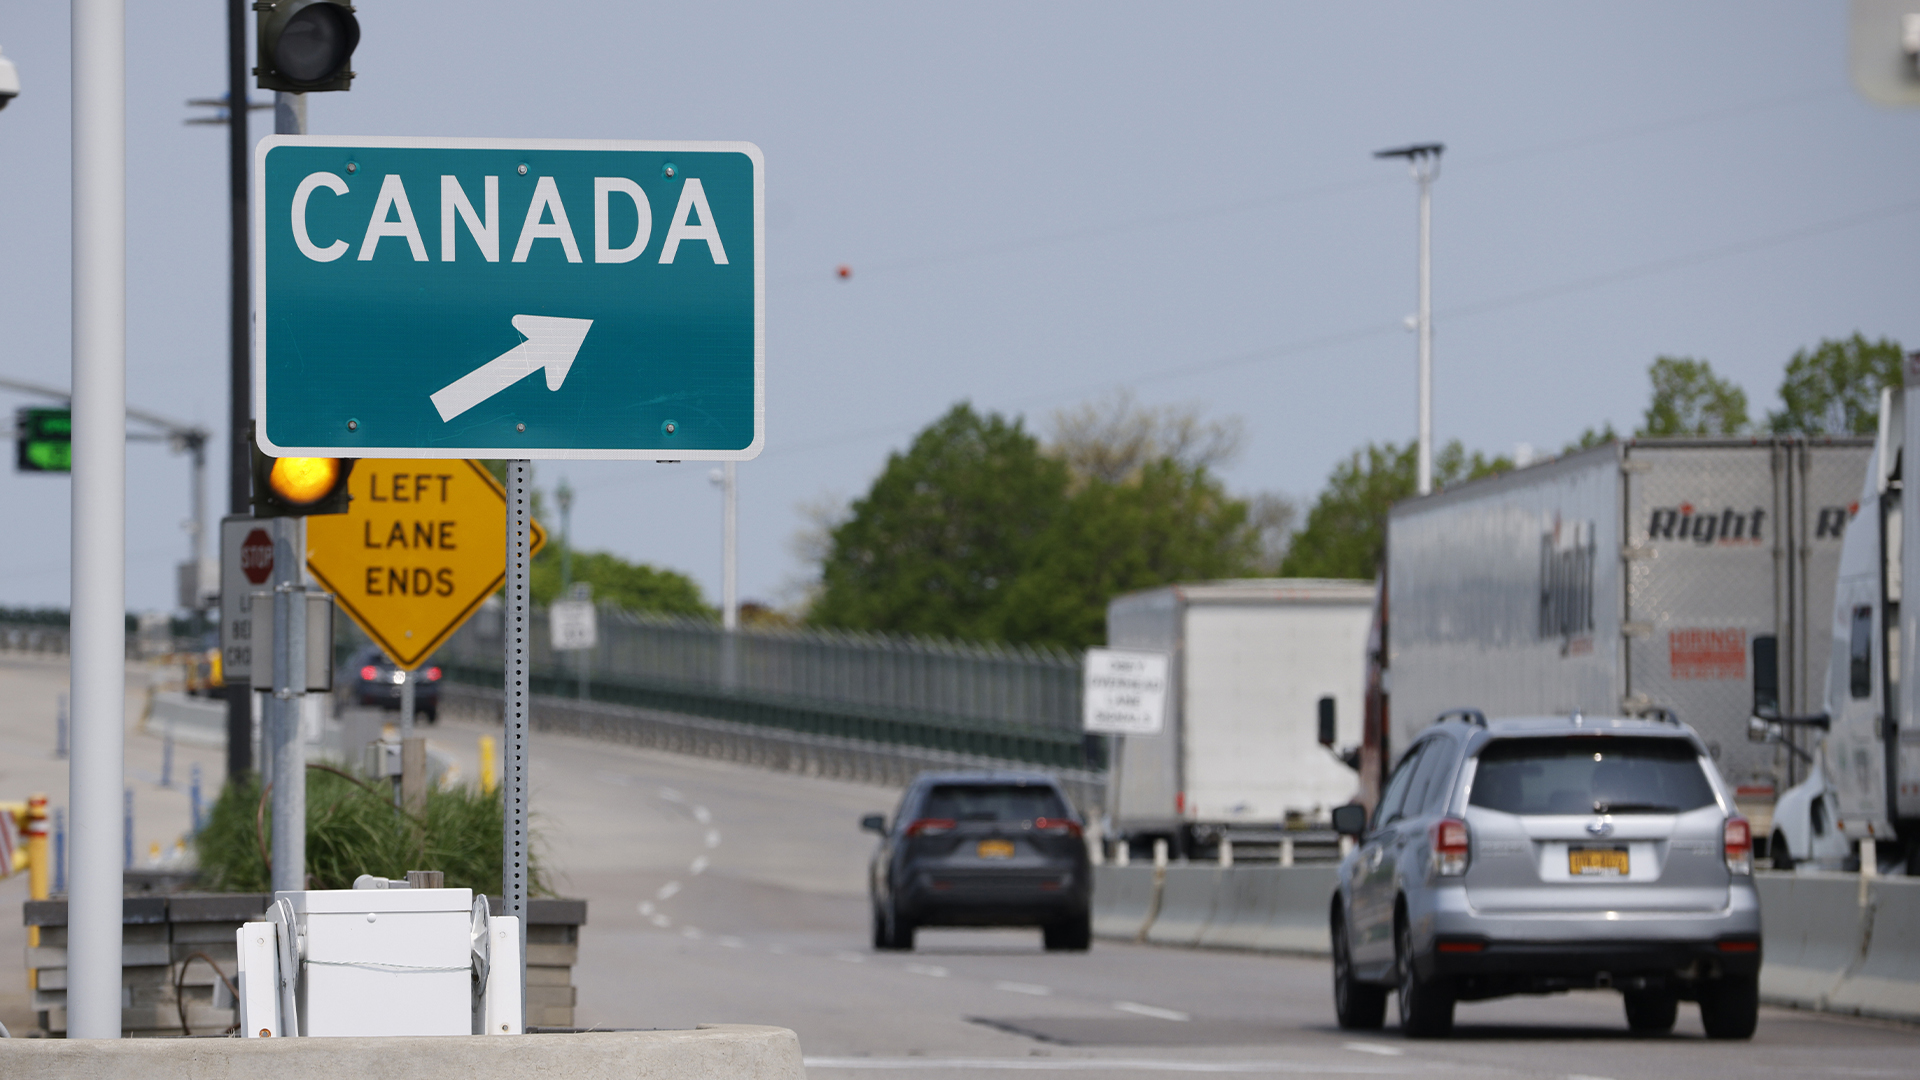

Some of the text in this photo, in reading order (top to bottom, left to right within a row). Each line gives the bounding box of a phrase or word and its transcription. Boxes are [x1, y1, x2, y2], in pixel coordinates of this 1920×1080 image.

[291, 171, 730, 265] CANADA
[370, 473, 454, 503] LEFT
[364, 520, 457, 551] LANE
[1650, 502, 1766, 547] Right
[241, 545, 273, 569] STOP
[365, 566, 454, 597] ENDS
